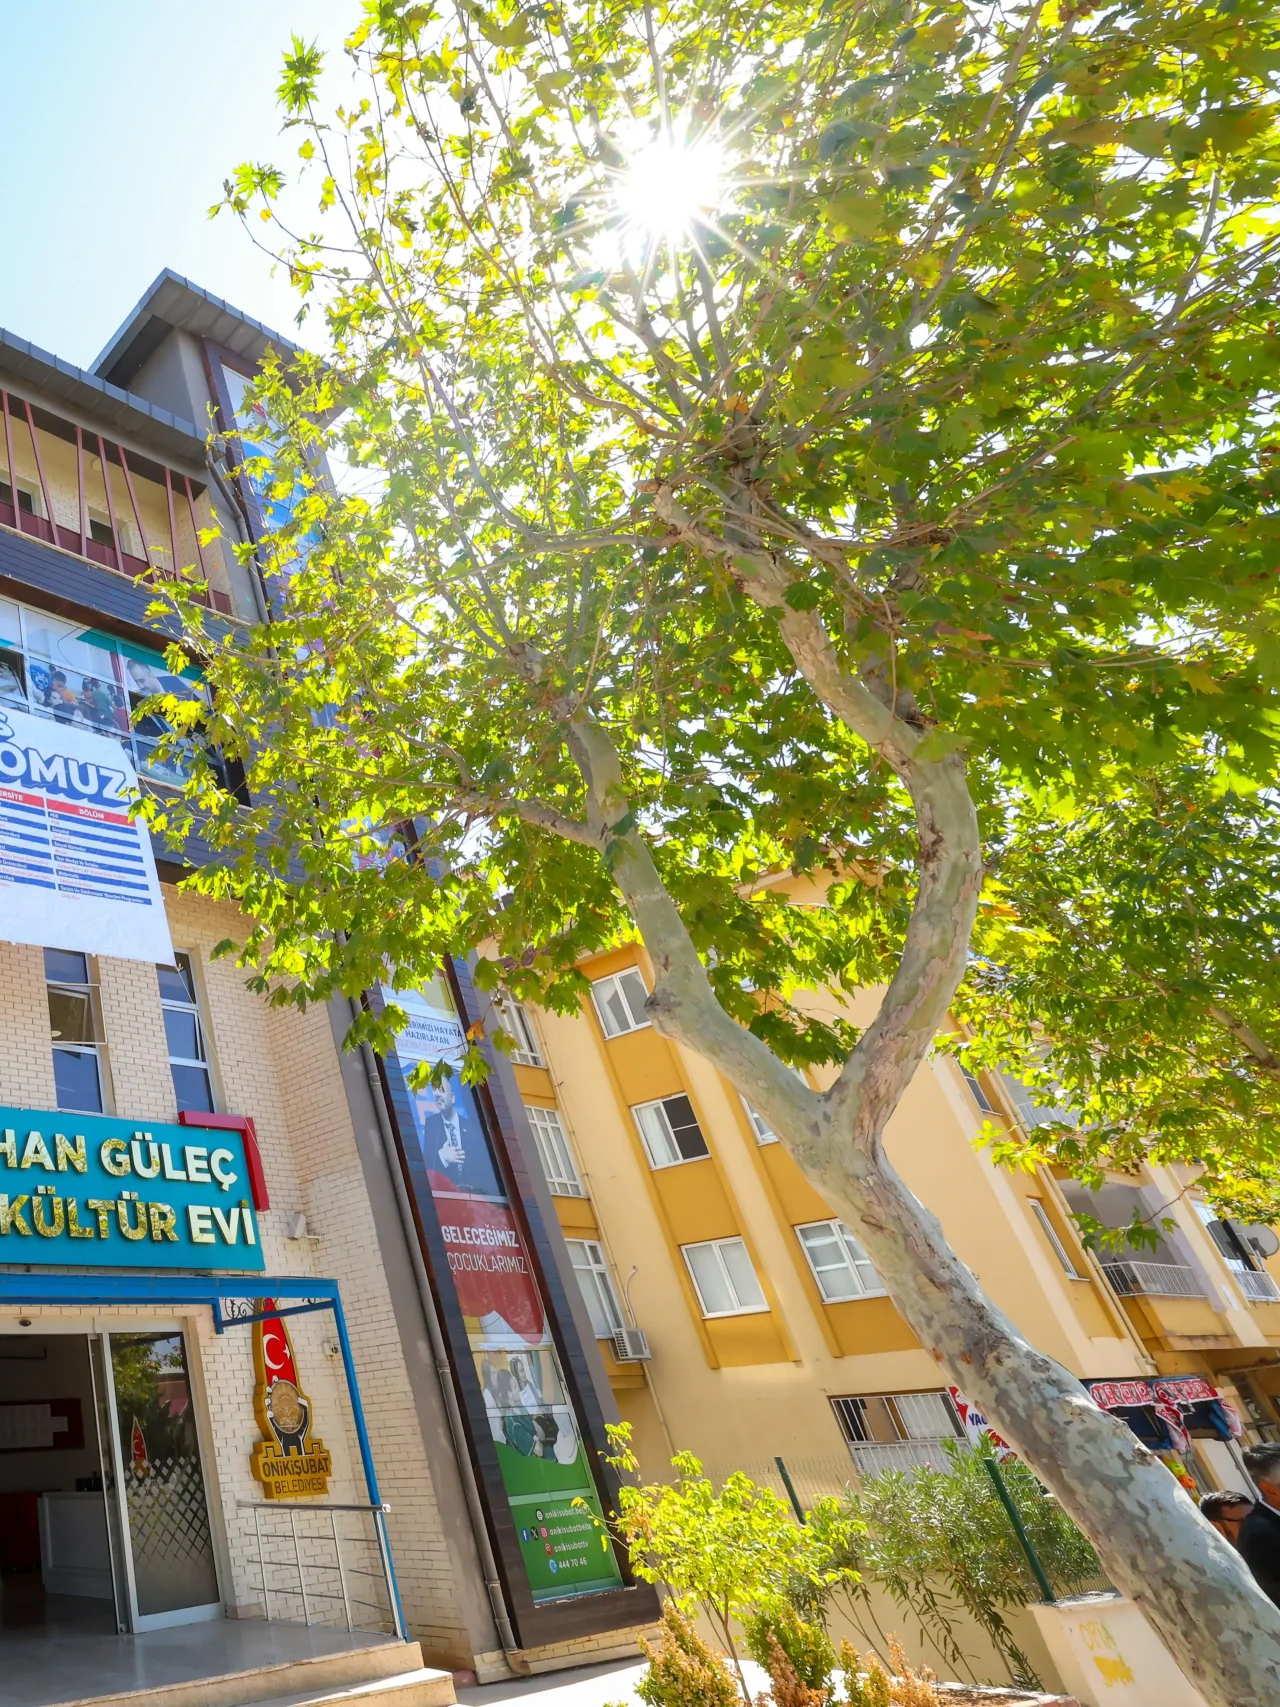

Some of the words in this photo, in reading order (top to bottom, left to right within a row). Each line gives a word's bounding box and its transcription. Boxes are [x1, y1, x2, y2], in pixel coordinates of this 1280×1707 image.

[79, 809, 104, 819] BÖLÜM
[99, 1132, 238, 1191] GÜLEÇ
[186, 1195, 255, 1245] EVİ
[442, 1224, 519, 1247] GELECEĞİMİZ
[447, 1252, 528, 1274] ÇOCUKLARIMIZ
[559, 1559, 570, 1568] 444
[580, 1557, 587, 1565] 46
